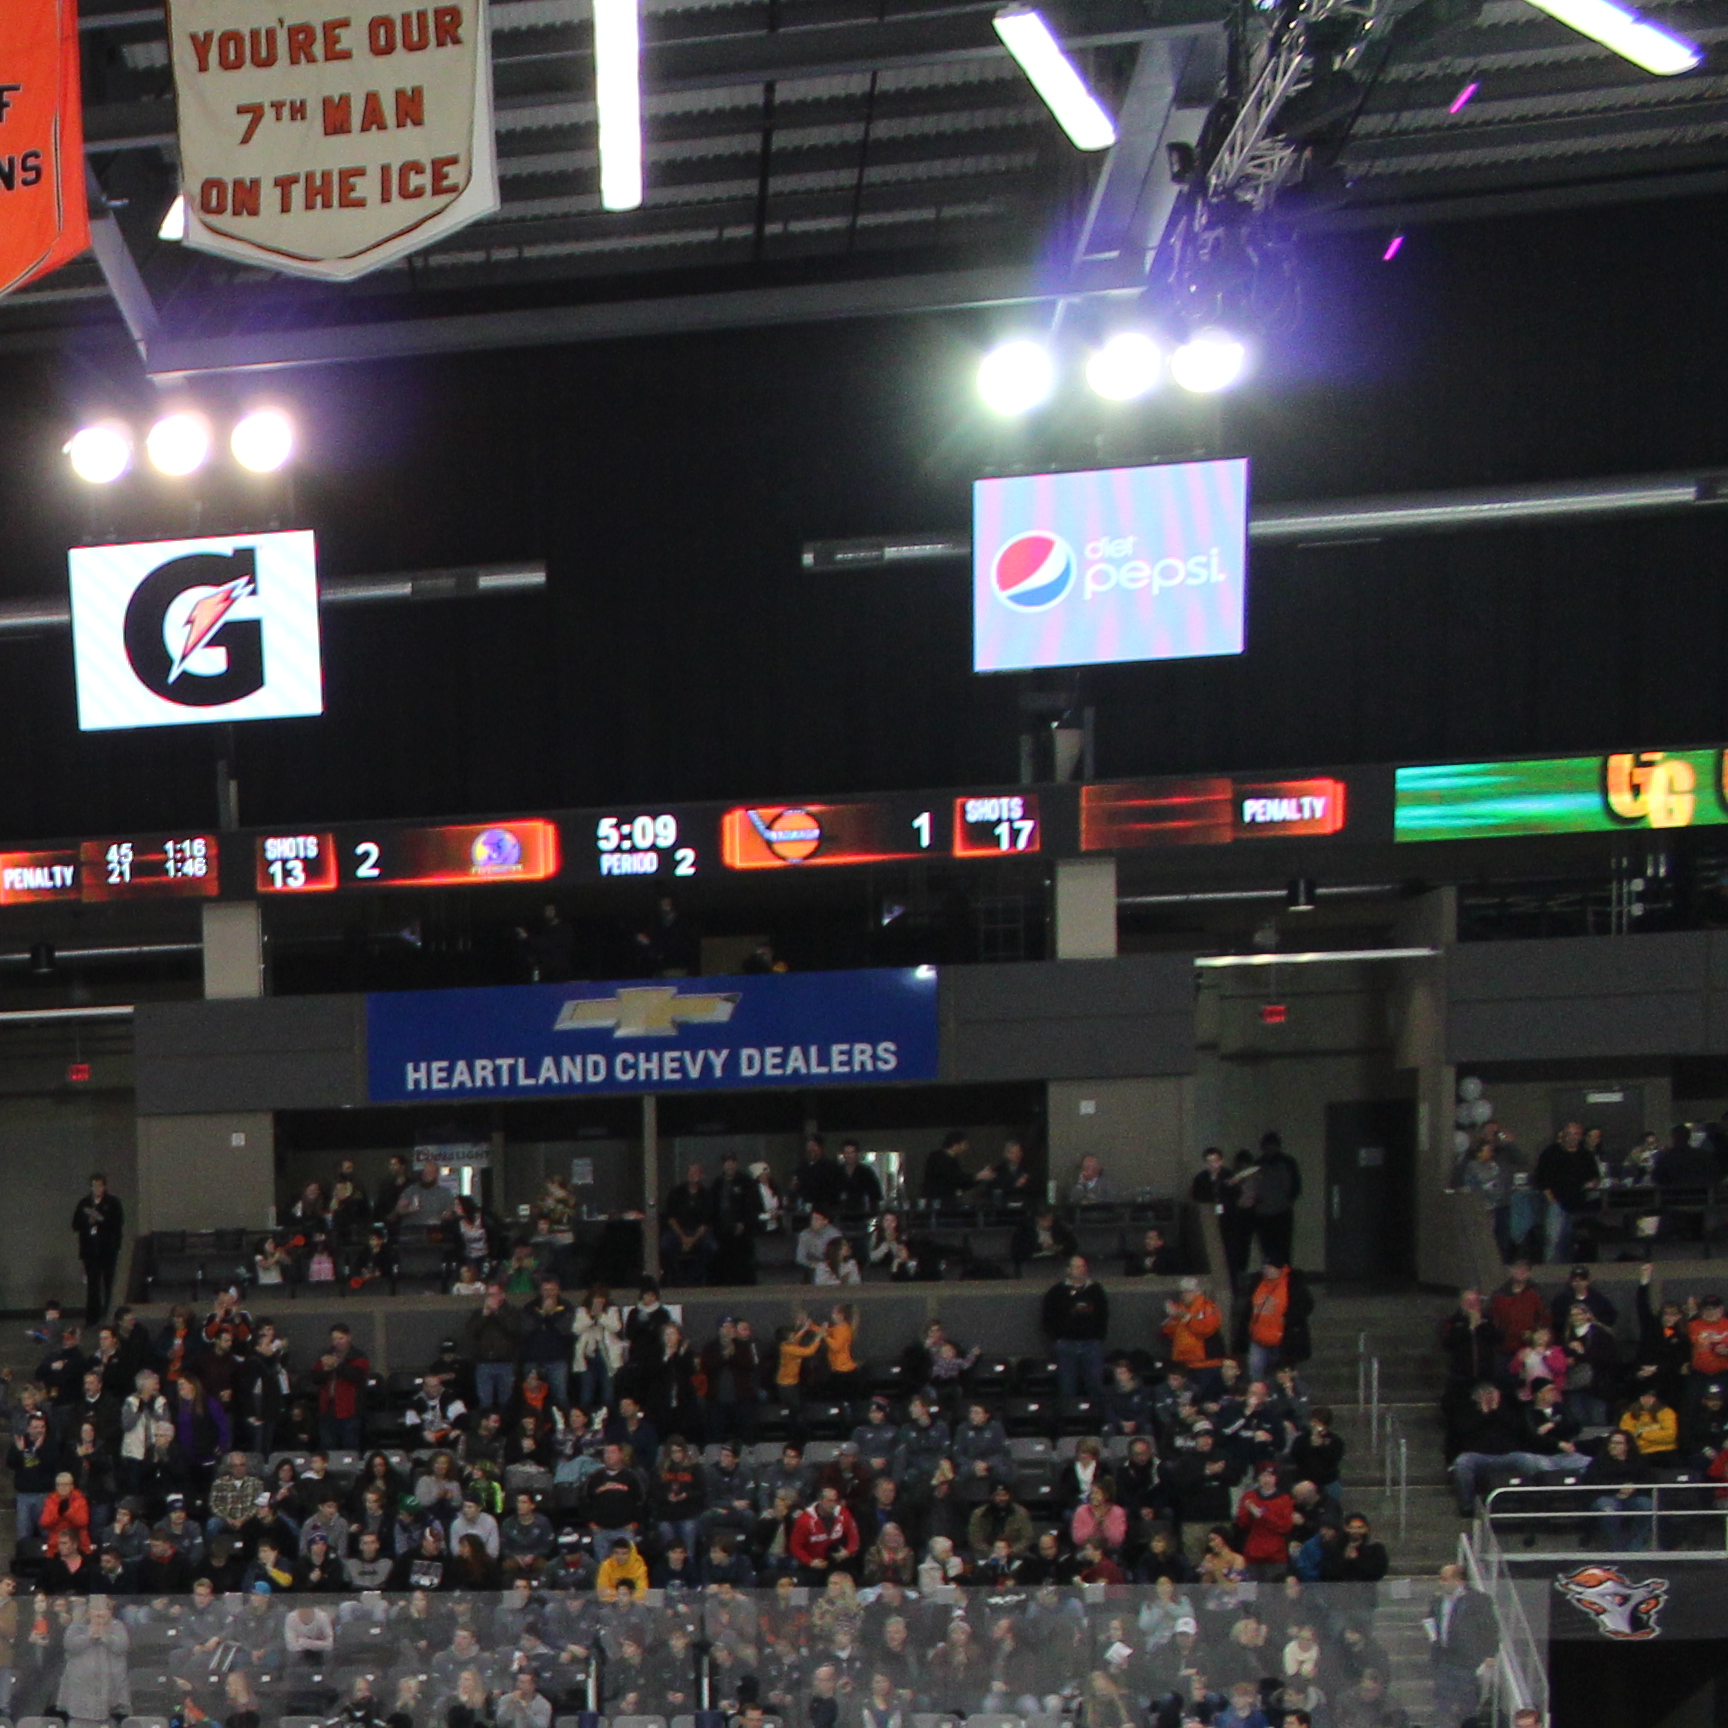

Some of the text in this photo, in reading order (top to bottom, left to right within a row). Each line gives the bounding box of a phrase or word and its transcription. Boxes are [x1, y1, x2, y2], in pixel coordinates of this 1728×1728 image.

[190, 5, 465, 73] YOU'RE OUR
[236, 85, 426, 145] 7TH MAN
[200, 154, 461, 218] ON THE ICE
[1084, 531, 1137, 561] diet
[965, 798, 1023, 823] SHOTS
[1243, 796, 1324, 825] PENALTY
[597, 816, 676, 851] 5:09
[912, 813, 932, 847] 1
[993, 820, 1034, 851] 17
[106, 843, 133, 863] 45
[264, 836, 318, 859] SHOTS
[355, 842, 381, 879] 2
[3, 866, 74, 889] PENALTY
[106, 863, 131, 883] 21
[268, 861, 305, 887] 13
[600, 850, 695, 876] PERIOD 2
[406, 1039, 897, 1091] HEARTLAND CHEVY DEALERS
